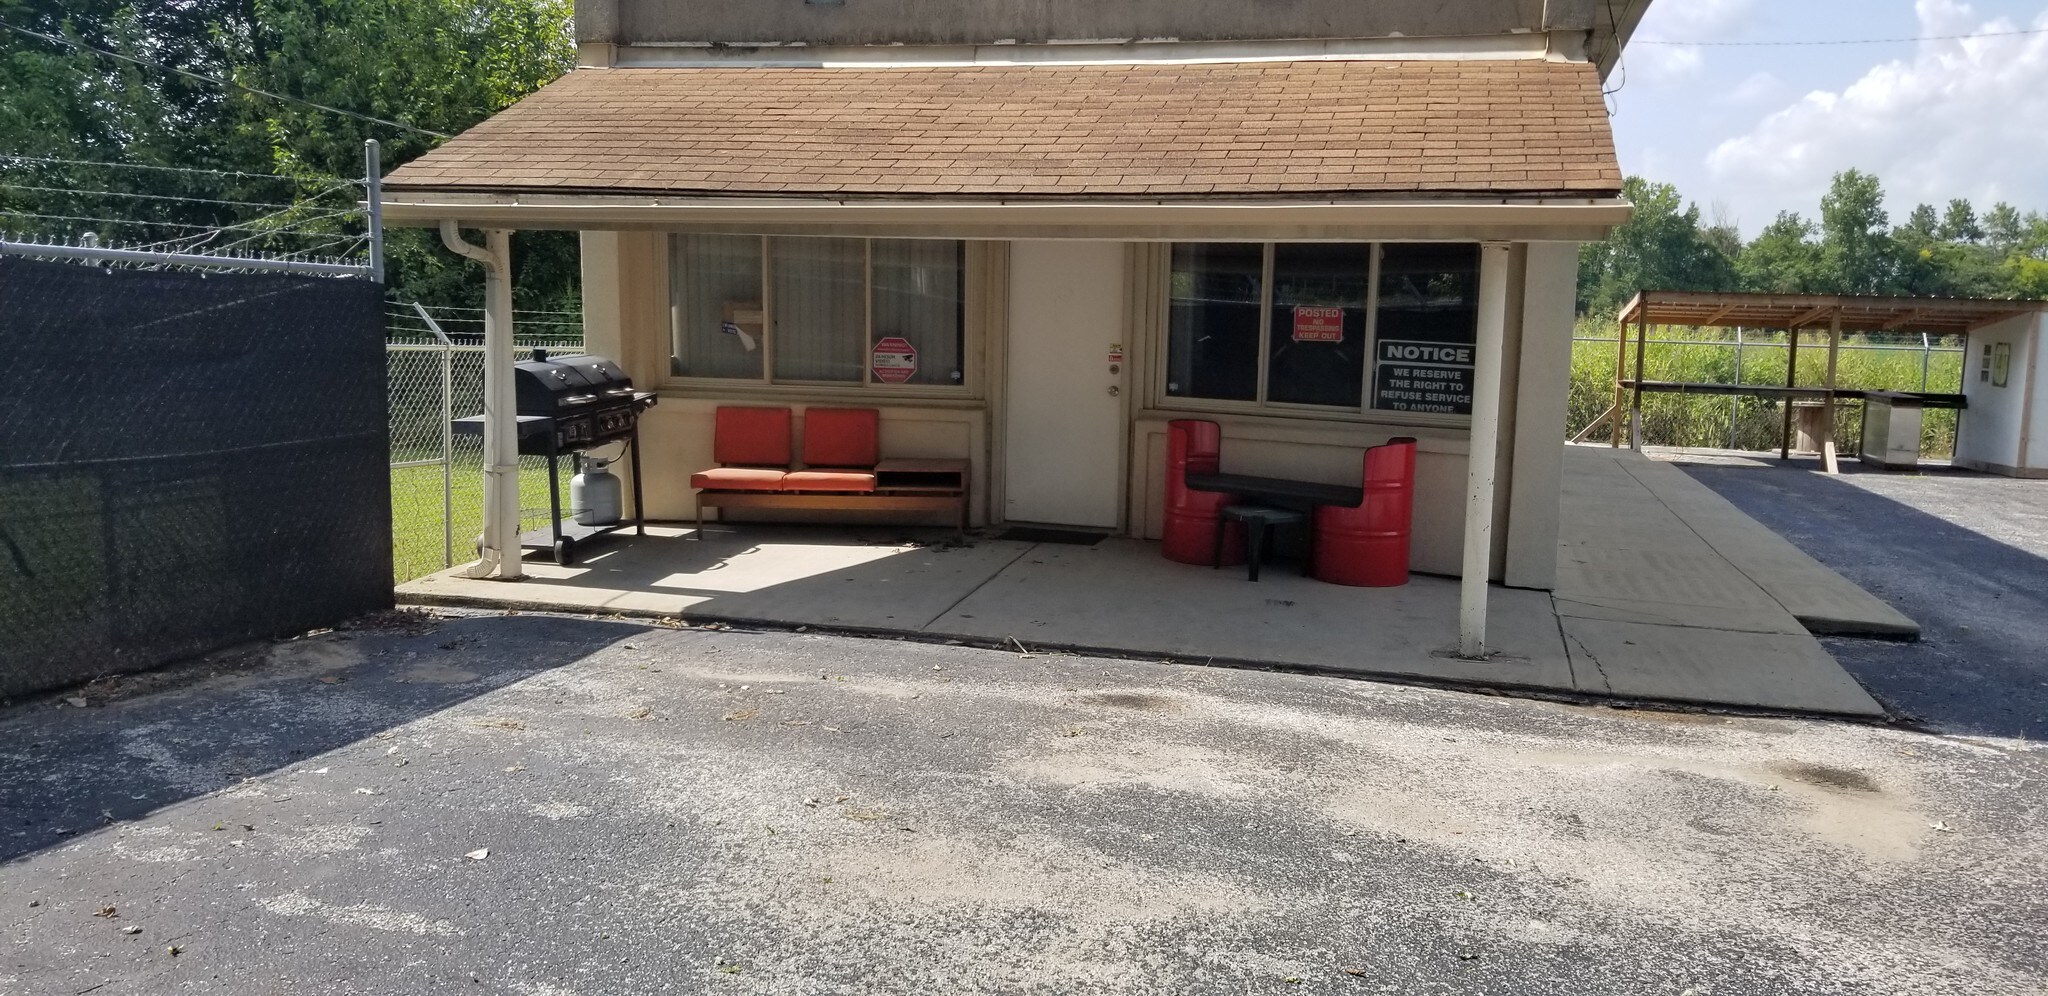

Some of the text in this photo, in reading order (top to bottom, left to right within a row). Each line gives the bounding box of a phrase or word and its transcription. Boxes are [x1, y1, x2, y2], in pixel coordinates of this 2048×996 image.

[1299, 309, 1338, 317] POSTED
[1387, 345, 1470, 362] NOTICE
[1393, 368, 1461, 380] WE RESERVE
[1389, 380, 1463, 392] THE RIGHT TO
[1380, 390, 1471, 403] REFUSE SERVICE
[1393, 402, 1407, 410] TO
